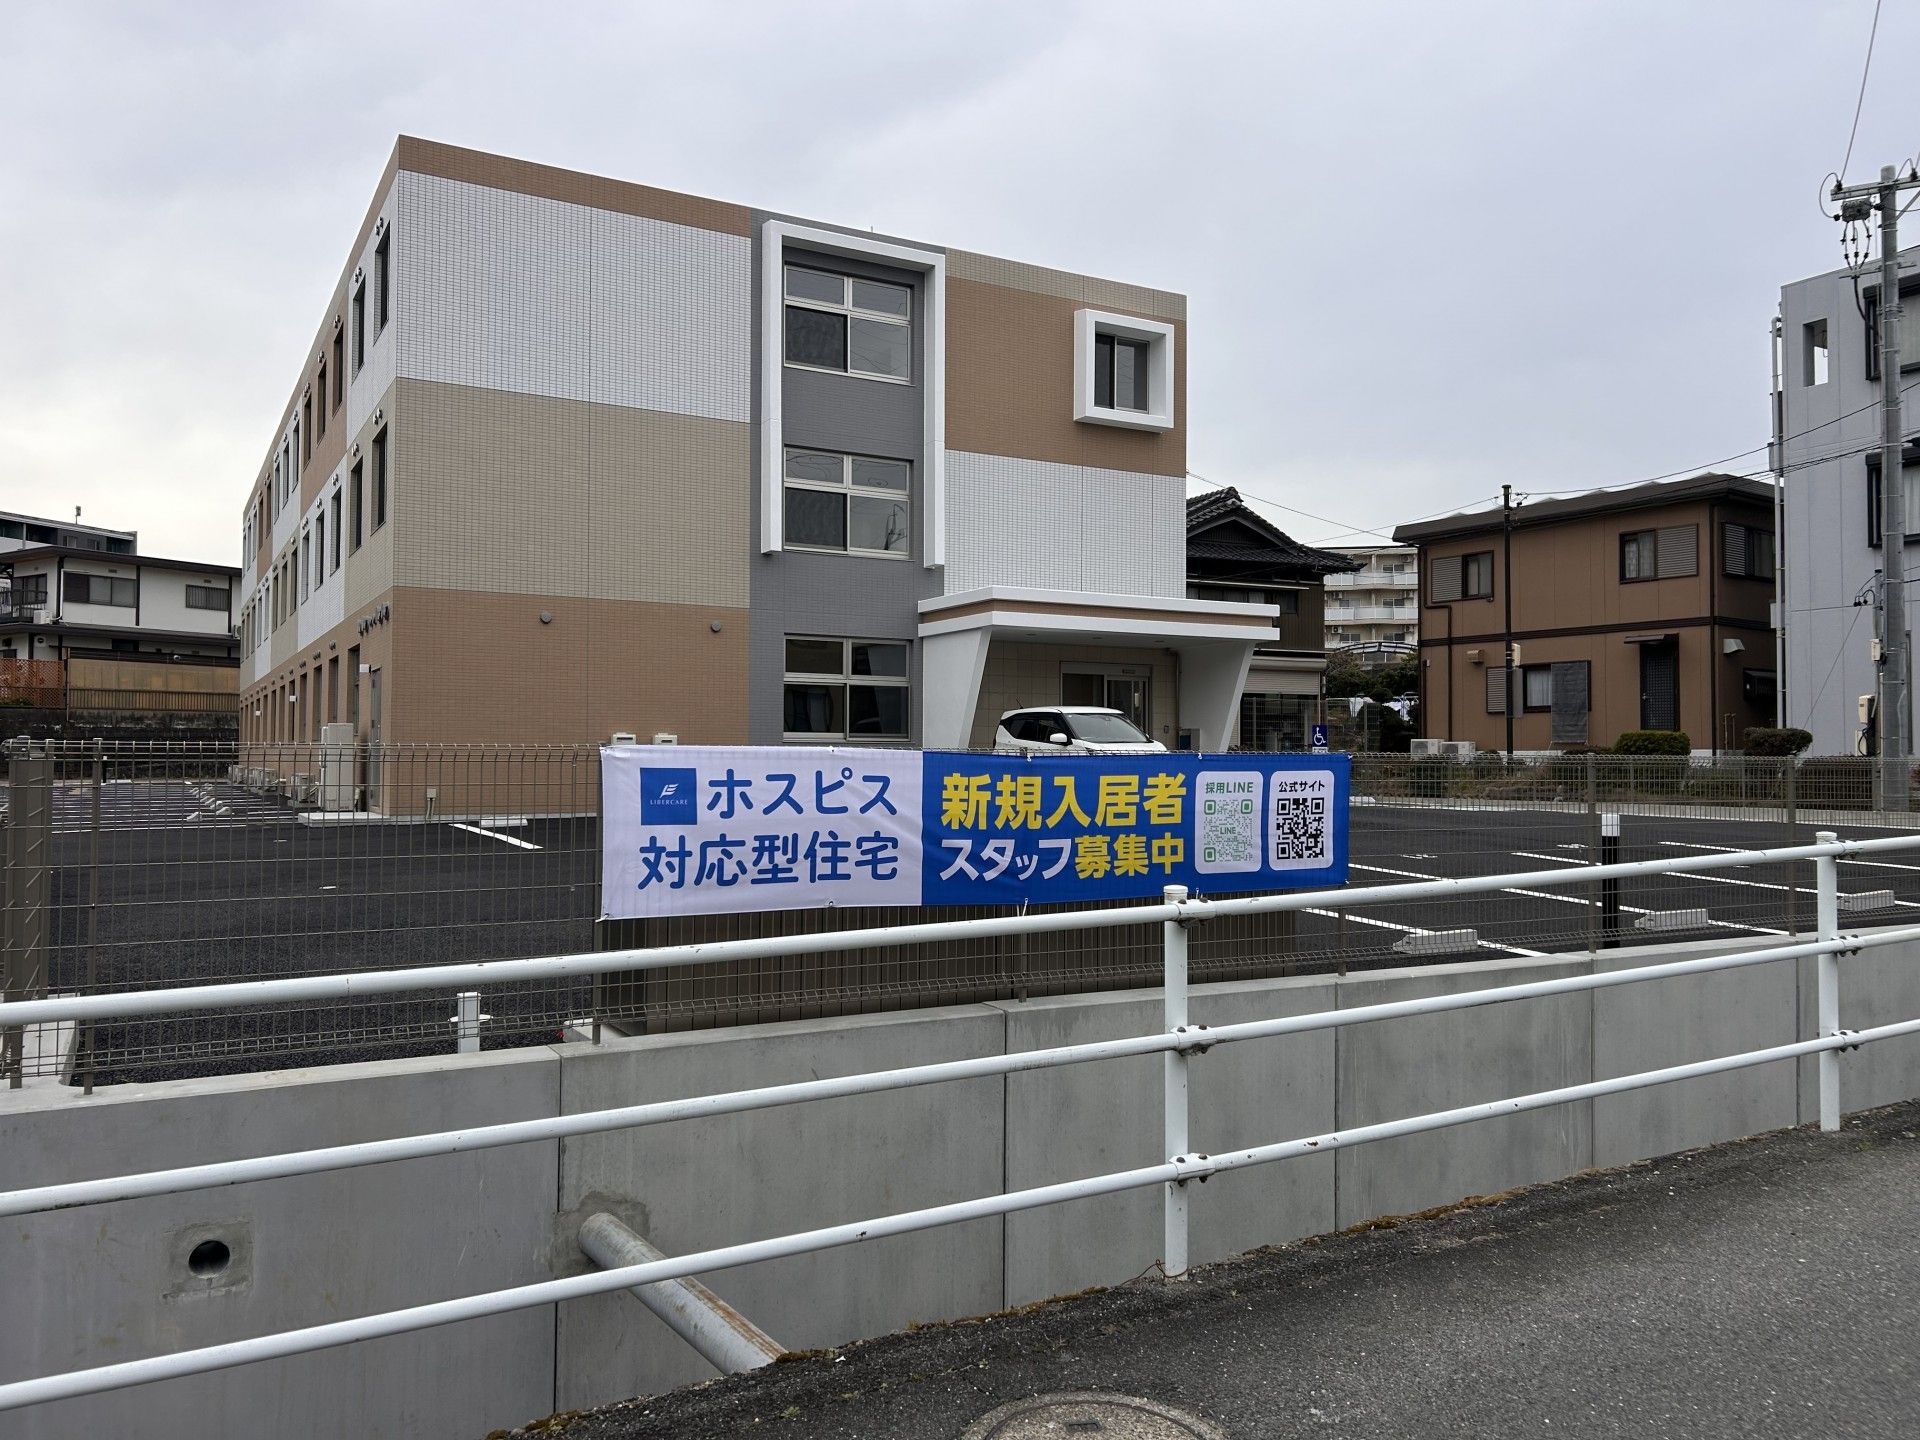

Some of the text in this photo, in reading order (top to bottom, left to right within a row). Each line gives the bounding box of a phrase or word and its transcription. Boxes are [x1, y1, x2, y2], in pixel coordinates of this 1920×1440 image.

[706, 767, 899, 820] ホスピス
[940, 773, 1187, 830] 新規入居者
[1205, 781, 1254, 794] 採用LINE
[1278, 780, 1325, 793] 公式サイト
[1220, 827, 1236, 835] LINE
[637, 830, 899, 890] 対応型住宅
[939, 832, 1185, 882] スタッフ募集中
